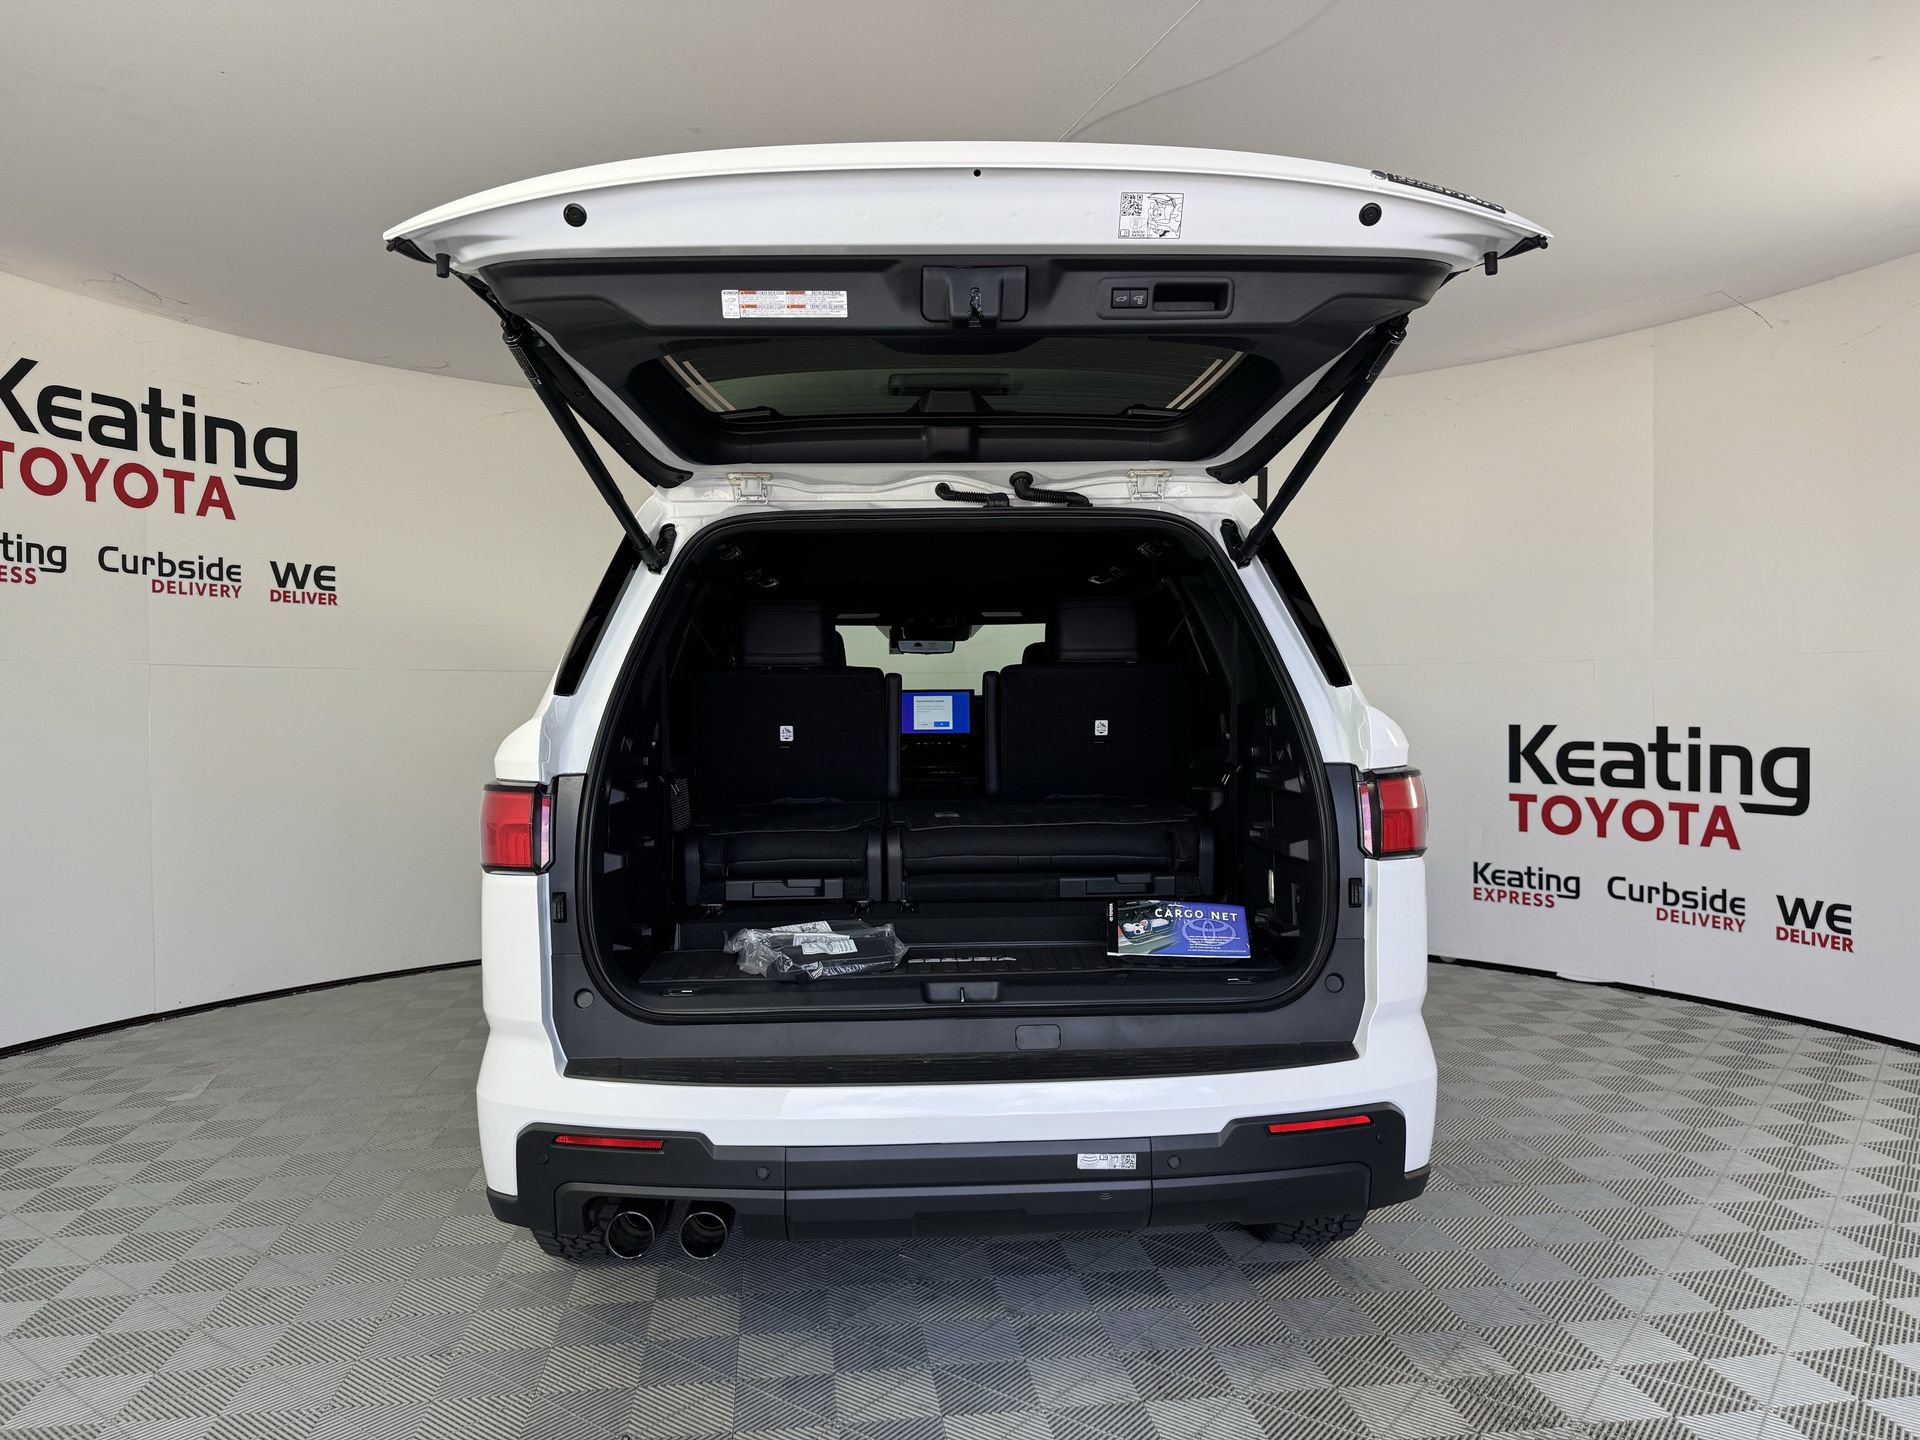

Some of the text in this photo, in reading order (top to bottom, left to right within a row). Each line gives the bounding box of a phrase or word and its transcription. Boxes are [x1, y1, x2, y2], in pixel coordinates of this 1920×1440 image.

[0, 357, 298, 491] Keating
[98, 545, 242, 583] Curbside
[269, 561, 336, 592] WE
[151, 579, 242, 598] DELIVERY
[269, 589, 338, 606] DELIVER
[1508, 724, 1811, 817] Keating
[1508, 793, 1741, 851] TOYOTA
[1472, 861, 1580, 900] Keating
[1607, 876, 1746, 917] Curbside
[1154, 908, 1238, 922] CARGO NET
[1472, 887, 1555, 909] EXPRESS
[1656, 907, 1746, 933] DELIVERY
[1775, 895, 1852, 936] WE
[1775, 926, 1854, 953] DELIVER
